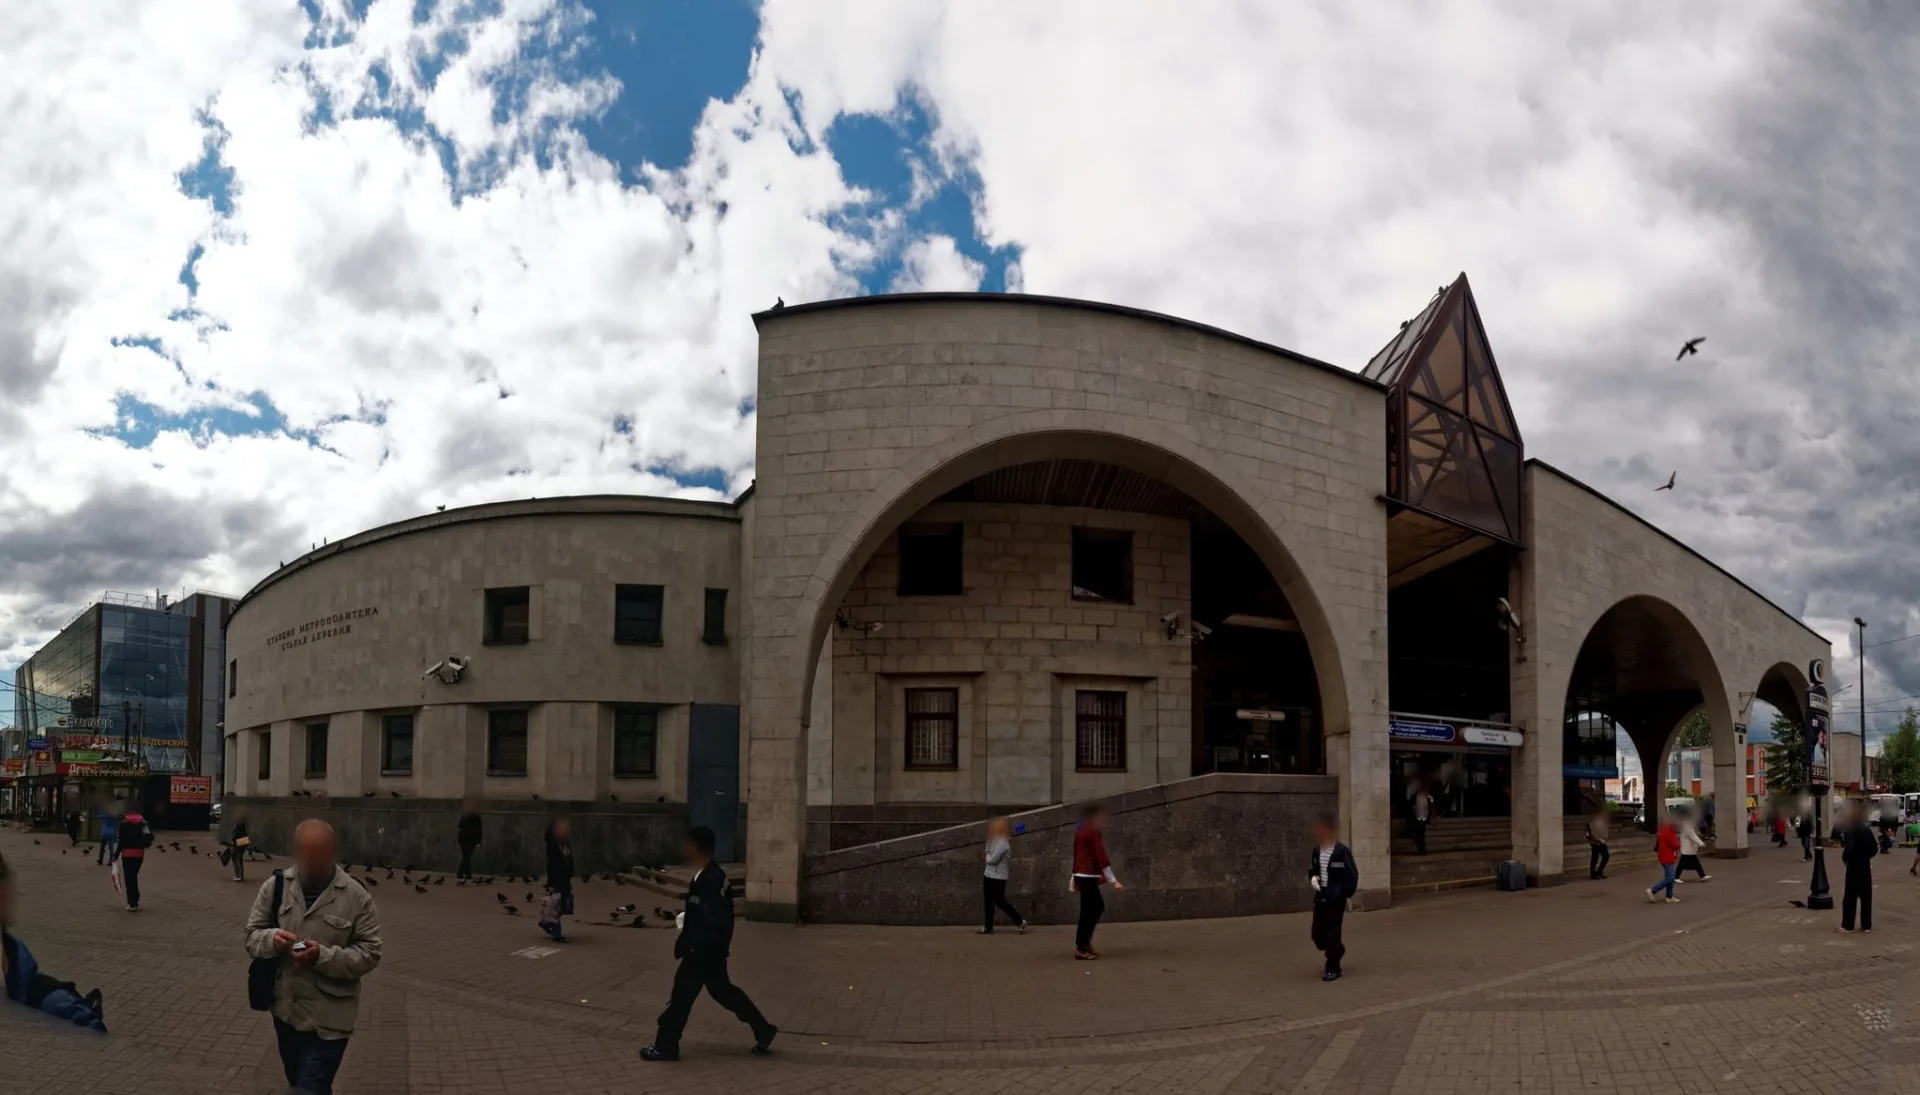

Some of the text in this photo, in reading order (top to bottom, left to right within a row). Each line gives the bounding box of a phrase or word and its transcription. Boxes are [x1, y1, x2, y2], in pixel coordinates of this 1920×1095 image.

[267, 606, 379, 646] СТАНЦИЯ МЕТРОПОЛИТЕНА
[281, 624, 351, 652] СТАРАЯ ДЕРЕВНЯ
